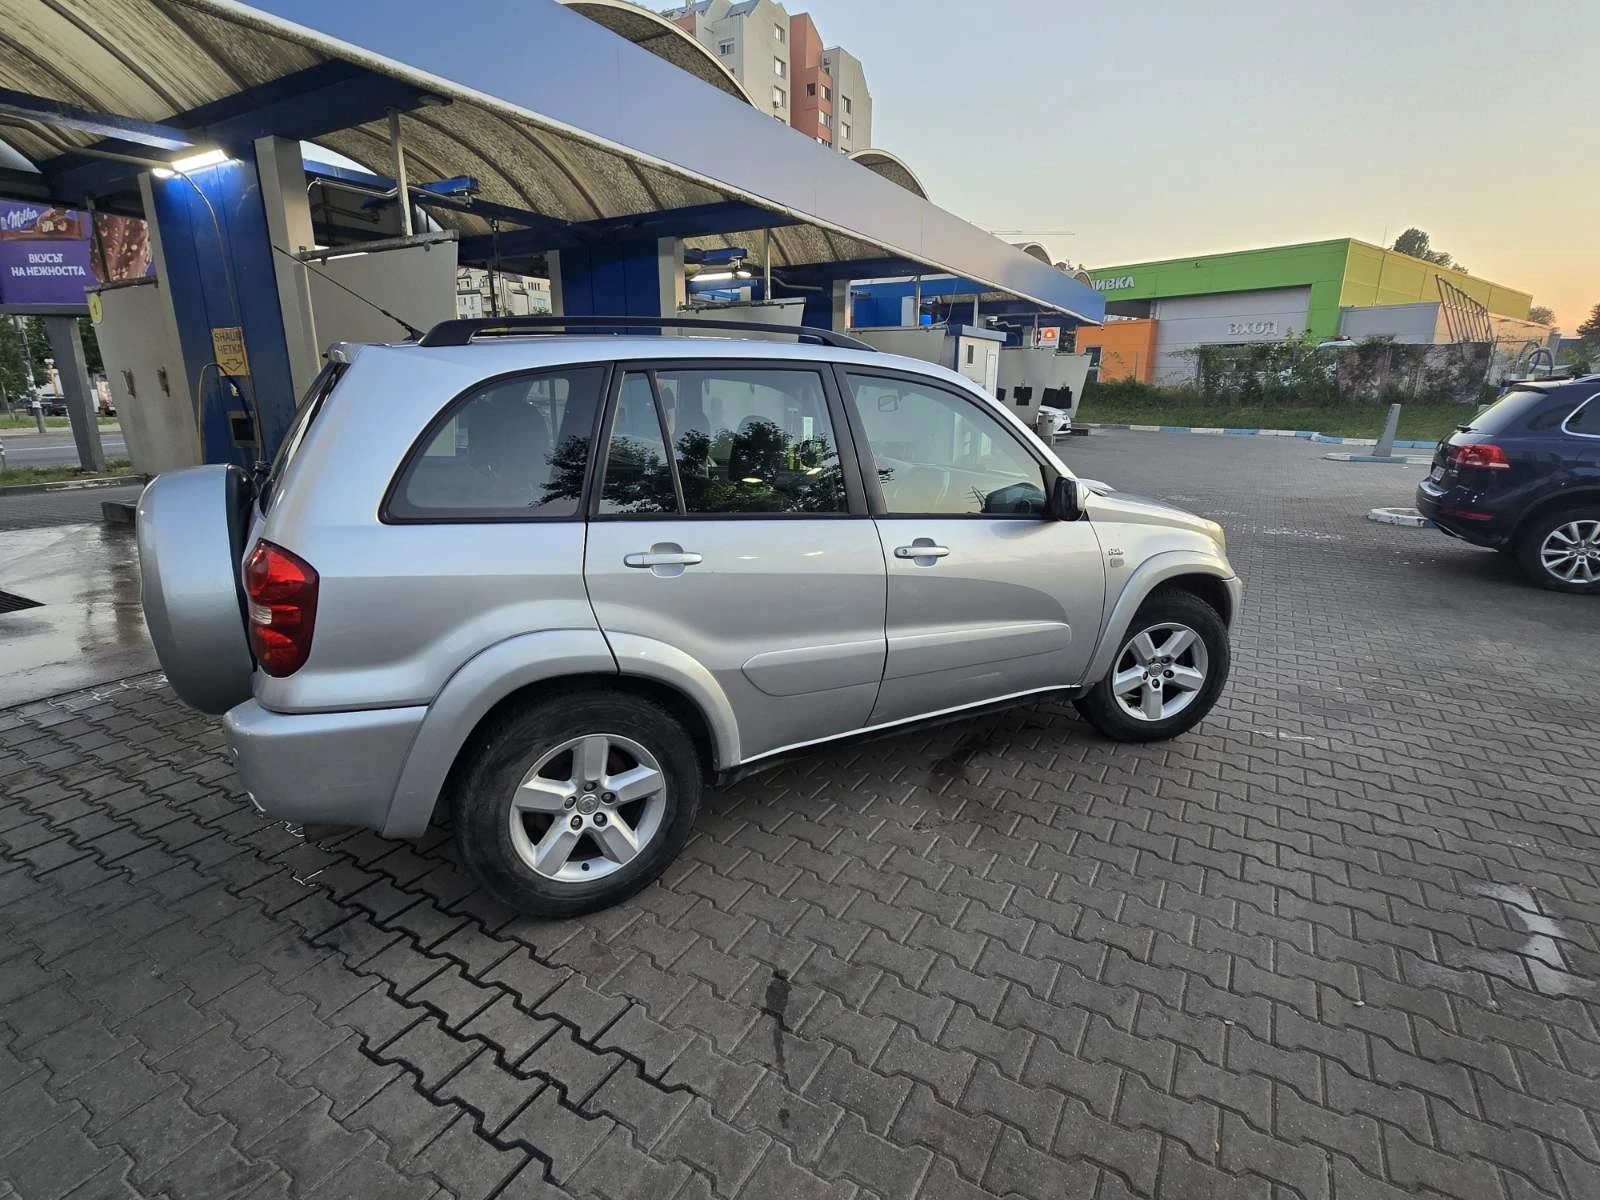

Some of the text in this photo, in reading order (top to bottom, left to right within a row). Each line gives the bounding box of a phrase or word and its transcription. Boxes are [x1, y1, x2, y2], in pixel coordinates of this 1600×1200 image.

[7, 207, 39, 229] Milka
[28, 253, 64, 263] ВКУСЪТ
[10, 265, 86, 276] НА НЕЖНОСТТА
[1227, 320, 1279, 337] ВХОД
